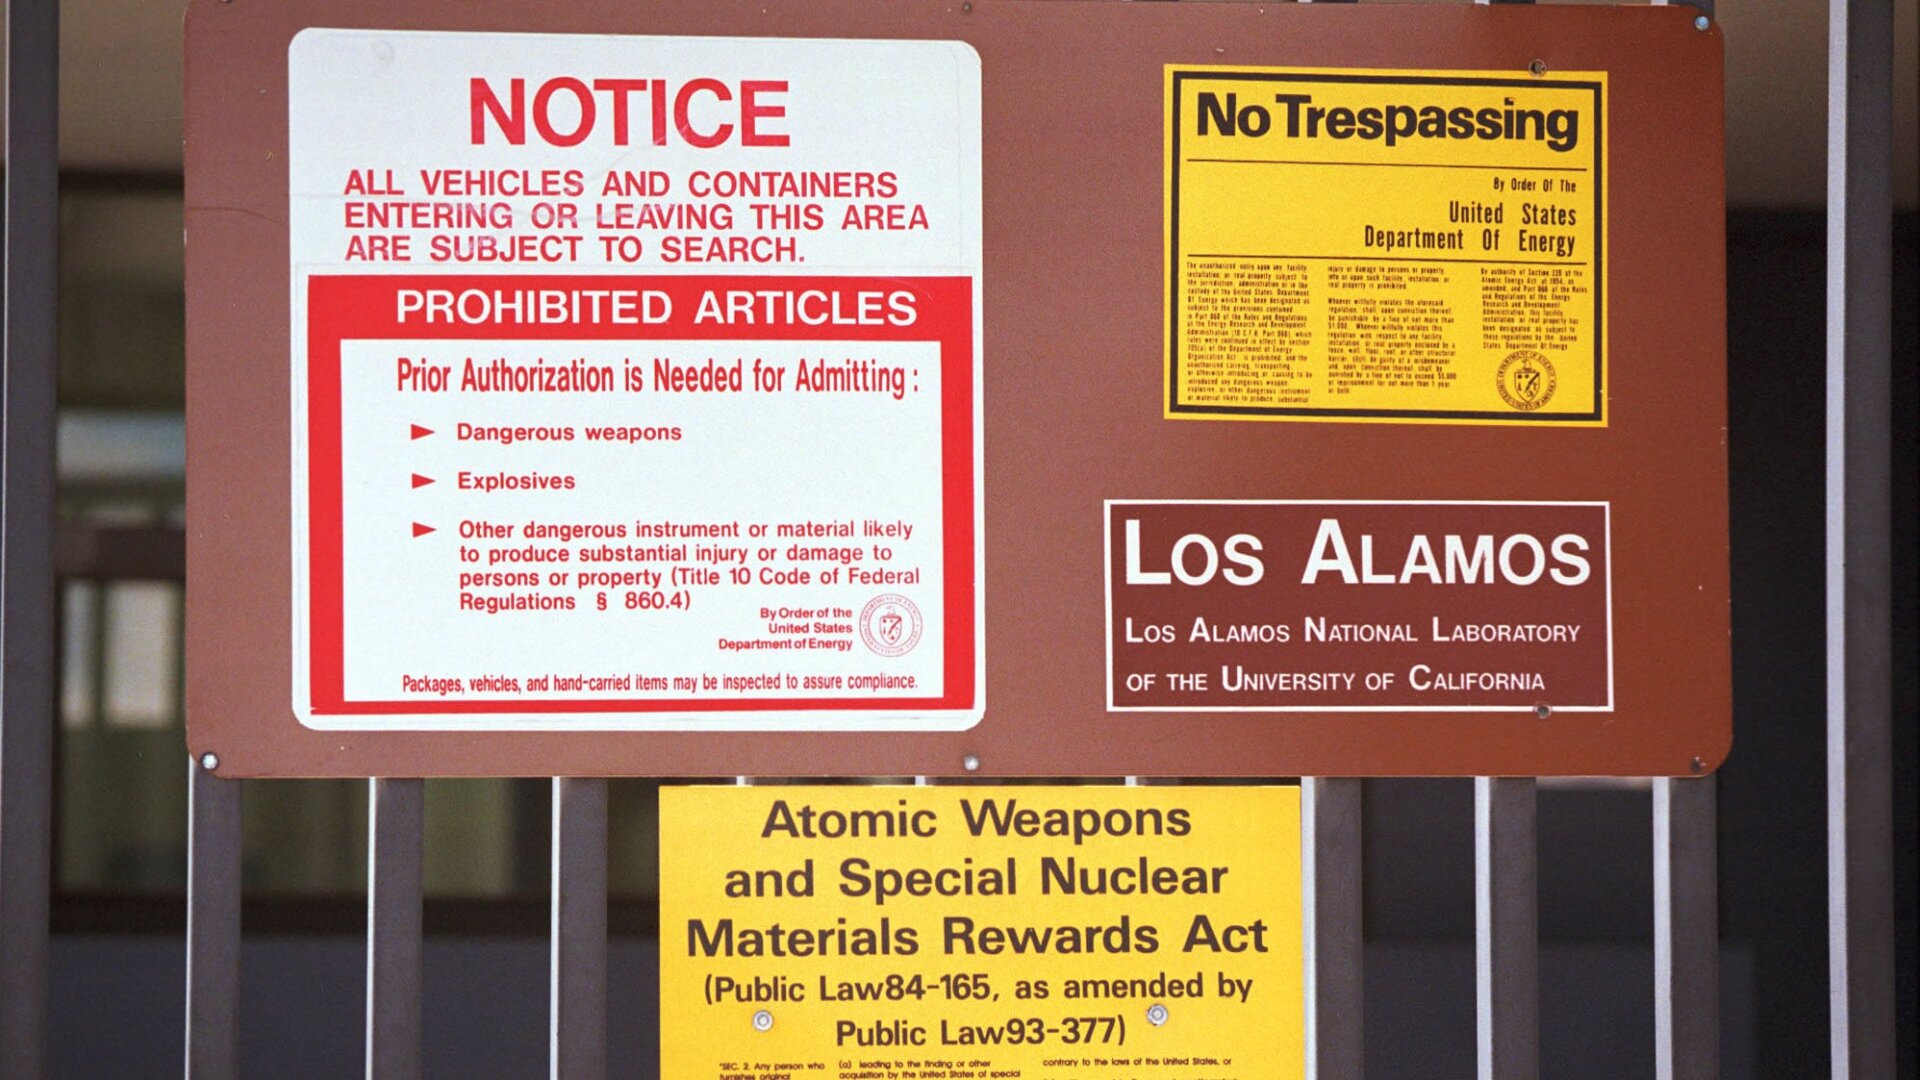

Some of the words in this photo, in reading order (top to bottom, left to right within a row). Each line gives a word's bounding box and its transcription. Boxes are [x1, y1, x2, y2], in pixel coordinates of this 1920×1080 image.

[470, 77, 790, 148] NOTICE
[1198, 92, 1271, 137] No
[1276, 94, 1578, 152] Trespassing
[344, 170, 404, 196] ALL
[420, 169, 584, 196] VEHICLES
[602, 171, 670, 196] AND
[689, 171, 897, 198] CONTAINERS
[1494, 177, 1504, 192] By
[1511, 178, 1536, 191] Order
[1543, 178, 1553, 192] Of
[1560, 179, 1576, 192] The
[345, 202, 512, 228] ENTERING
[531, 203, 578, 229] OR
[596, 203, 732, 230] LEAVING
[749, 203, 823, 230] THIS
[842, 205, 928, 230] AREA
[1450, 201, 1503, 223] United
[1522, 203, 1576, 225] States
[345, 236, 411, 261] ARE
[430, 235, 583, 262] SUBJECT
[599, 236, 642, 262] TO
[661, 236, 804, 262] SEARCH.
[1365, 225, 1463, 252] Department
[1483, 228, 1499, 250] Of
[1519, 225, 1575, 257] Energy
[398, 289, 672, 324] PROHIBITED
[694, 290, 916, 326] ARTICLES
[398, 358, 451, 392] Prior
[461, 358, 613, 392] Authorization
[625, 358, 643, 392] is
[654, 358, 742, 392] Needed
[753, 358, 785, 392] for
[457, 423, 574, 445] Dangerous
[585, 427, 682, 444] weapons
[458, 472, 575, 493] Explosives
[459, 520, 514, 538] Other
[523, 521, 627, 542] dangerous
[636, 520, 739, 538] instrument
[749, 524, 768, 537] or
[777, 520, 854, 537] material
[864, 520, 912, 540] likely
[460, 545, 479, 562] to
[489, 544, 569, 565] produce
[579, 544, 686, 562] substantial
[696, 544, 748, 565] injury
[758, 548, 777, 561] or
[786, 544, 863, 565] damage
[873, 545, 892, 561] to
[460, 573, 539, 589] persons
[549, 573, 569, 587] or
[578, 569, 661, 589] property
[671, 567, 720, 587] (Title
[730, 567, 751, 585] 10
[759, 567, 810, 585] Code
[820, 567, 839, 584] of
[849, 567, 919, 584] Federal
[460, 592, 575, 612] Regulations
[625, 591, 690, 611] 860.4)
[760, 608, 777, 620] By
[779, 607, 814, 619] Order
[816, 608, 829, 618] of
[833, 608, 852, 618] the
[769, 623, 809, 634] United
[814, 622, 852, 633] States
[719, 639, 792, 652] Department
[794, 638, 806, 649] of
[808, 638, 852, 651] Energy
[403, 675, 464, 696] Packages,
[469, 675, 521, 694] vehicles,
[527, 674, 548, 691] and
[554, 674, 630, 691] hand-carried
[636, 674, 668, 691] items
[674, 677, 697, 693] may
[703, 674, 717, 690] be
[722, 673, 780, 693] inspected
[786, 674, 798, 690] to
[803, 676, 842, 689] assure
[848, 673, 918, 691] compliance.
[1126, 674, 1156, 691] OF
[1166, 674, 1208, 691] THE
[1365, 673, 1394, 690] OF
[761, 800, 936, 838] Atomic
[960, 799, 1191, 845] Weapons
[725, 859, 814, 898] and
[839, 857, 1016, 905] Special
[1041, 857, 1228, 895] Nuclear
[688, 917, 919, 957] Materials
[944, 915, 1159, 955] Rewards
[1183, 915, 1268, 953] Act
[705, 974, 804, 1005] (Public
[1015, 980, 1049, 999] as
[1064, 972, 1203, 998] amended
[1218, 972, 1253, 1003] by
[837, 1020, 926, 1046] Public
[754, 1062, 770, 1072] Any
[774, 1063, 803, 1072] person
[808, 1062, 825, 1070] who
[838, 1060, 852, 1069] (a)
[859, 1060, 891, 1069] leading
[895, 1060, 903, 1068] to
[907, 1060, 921, 1068] the
[925, 1060, 952, 1069] finding
[1042, 1058, 1078, 1067] contrary
[1082, 1058, 1091, 1066] to
[1094, 1058, 1108, 1066] the
[1111, 1058, 1130, 1066] laws
[1133, 1057, 1142, 1066] of
[1145, 1057, 1159, 1066] the
[1163, 1057, 1189, 1066] United
[838, 1071, 884, 1080] acquisition
[888, 1071, 898, 1080] by
[902, 1070, 916, 1078] the
[919, 1070, 946, 1078] United
[949, 1070, 974, 1078] States
[978, 1070, 987, 1078] of
[990, 1070, 1021, 1079] special
